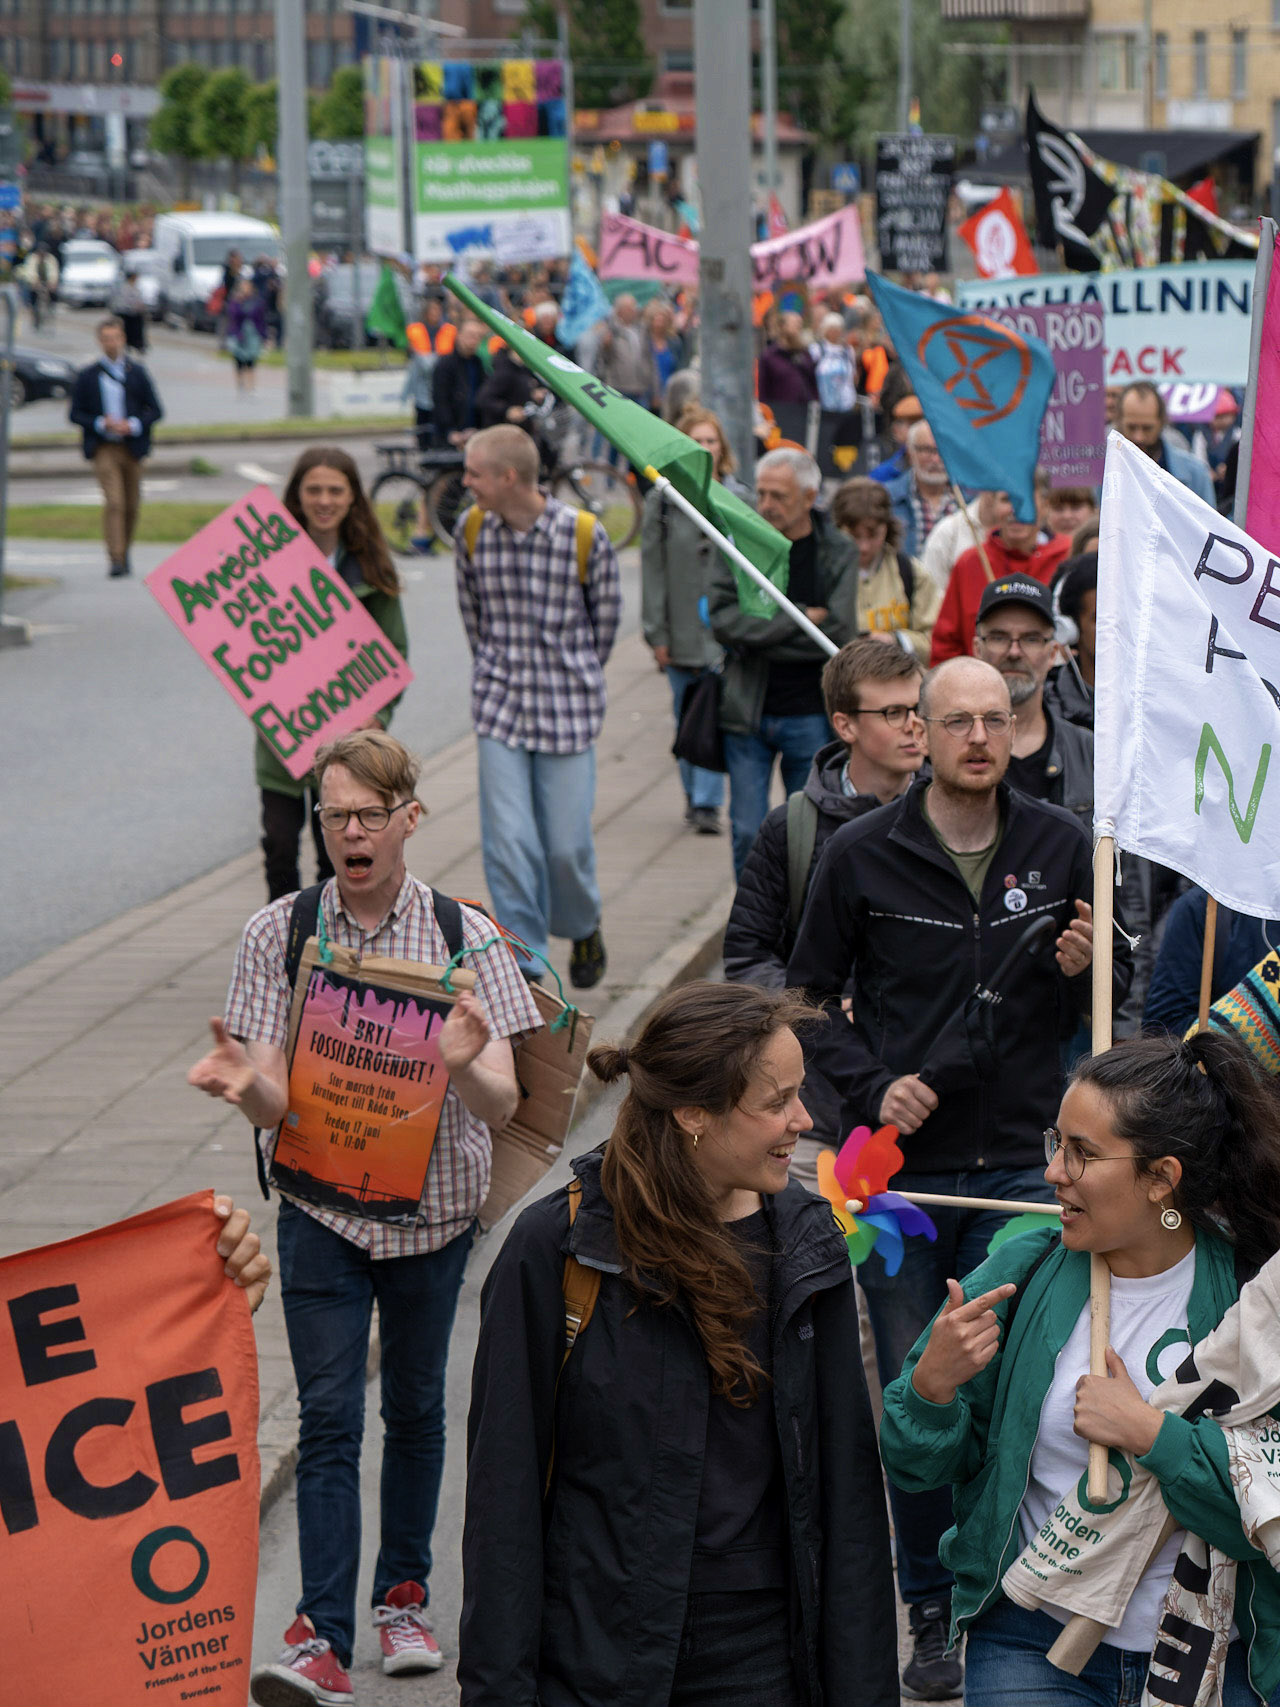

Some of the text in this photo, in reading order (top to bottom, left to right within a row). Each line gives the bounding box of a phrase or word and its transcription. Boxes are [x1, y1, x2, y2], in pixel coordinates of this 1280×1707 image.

[606, 237, 680, 271] AC
[1046, 307, 1104, 351] RÖD
[1104, 347, 1186, 376] ACK
[222, 572, 277, 628] DEN
[251, 638, 398, 760] Ekonomin
[354, 1018, 395, 1048] BRYT
[311, 1081, 410, 1121] Järntorget till Röda Sten
[328, 1071, 396, 1101] Stor marsch från
[324, 1111, 382, 1139] Fredag 17 juni
[343, 1134, 367, 1152] 17:00
[1039, 1520, 1084, 1561] änne
[1054, 1504, 1106, 1545] orden
[1038, 1551, 1048, 1561] of
[1059, 1563, 1083, 1576] Earth
[135, 1605, 236, 1645] Jordens
[138, 1634, 230, 1671] Vänner
[144, 1657, 244, 1690] Friends of the Earth
[180, 1684, 222, 1701] Sweden
